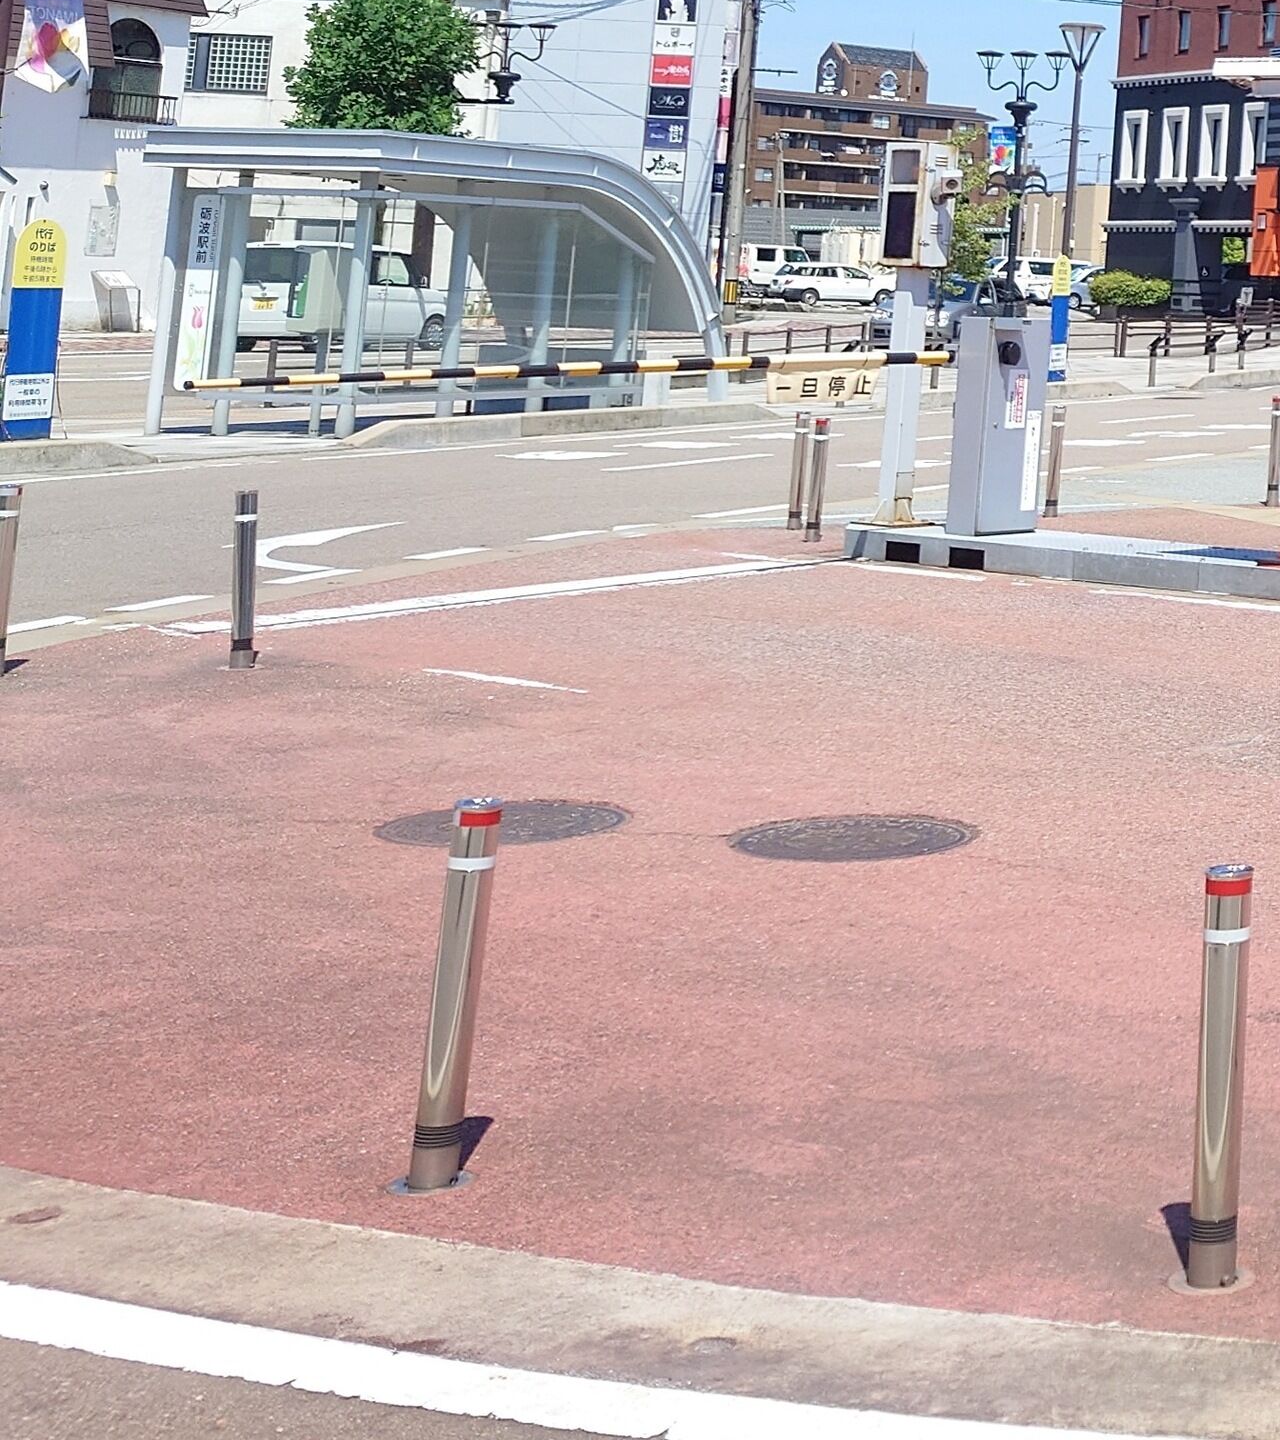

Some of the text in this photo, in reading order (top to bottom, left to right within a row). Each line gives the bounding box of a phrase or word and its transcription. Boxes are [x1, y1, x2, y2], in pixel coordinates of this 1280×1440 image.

[35, 227, 54, 240] 代行
[195, 207, 213, 264] 砺波駅前
[29, 241, 57, 253] のりば
[776, 375, 871, 398] 一旦停止
